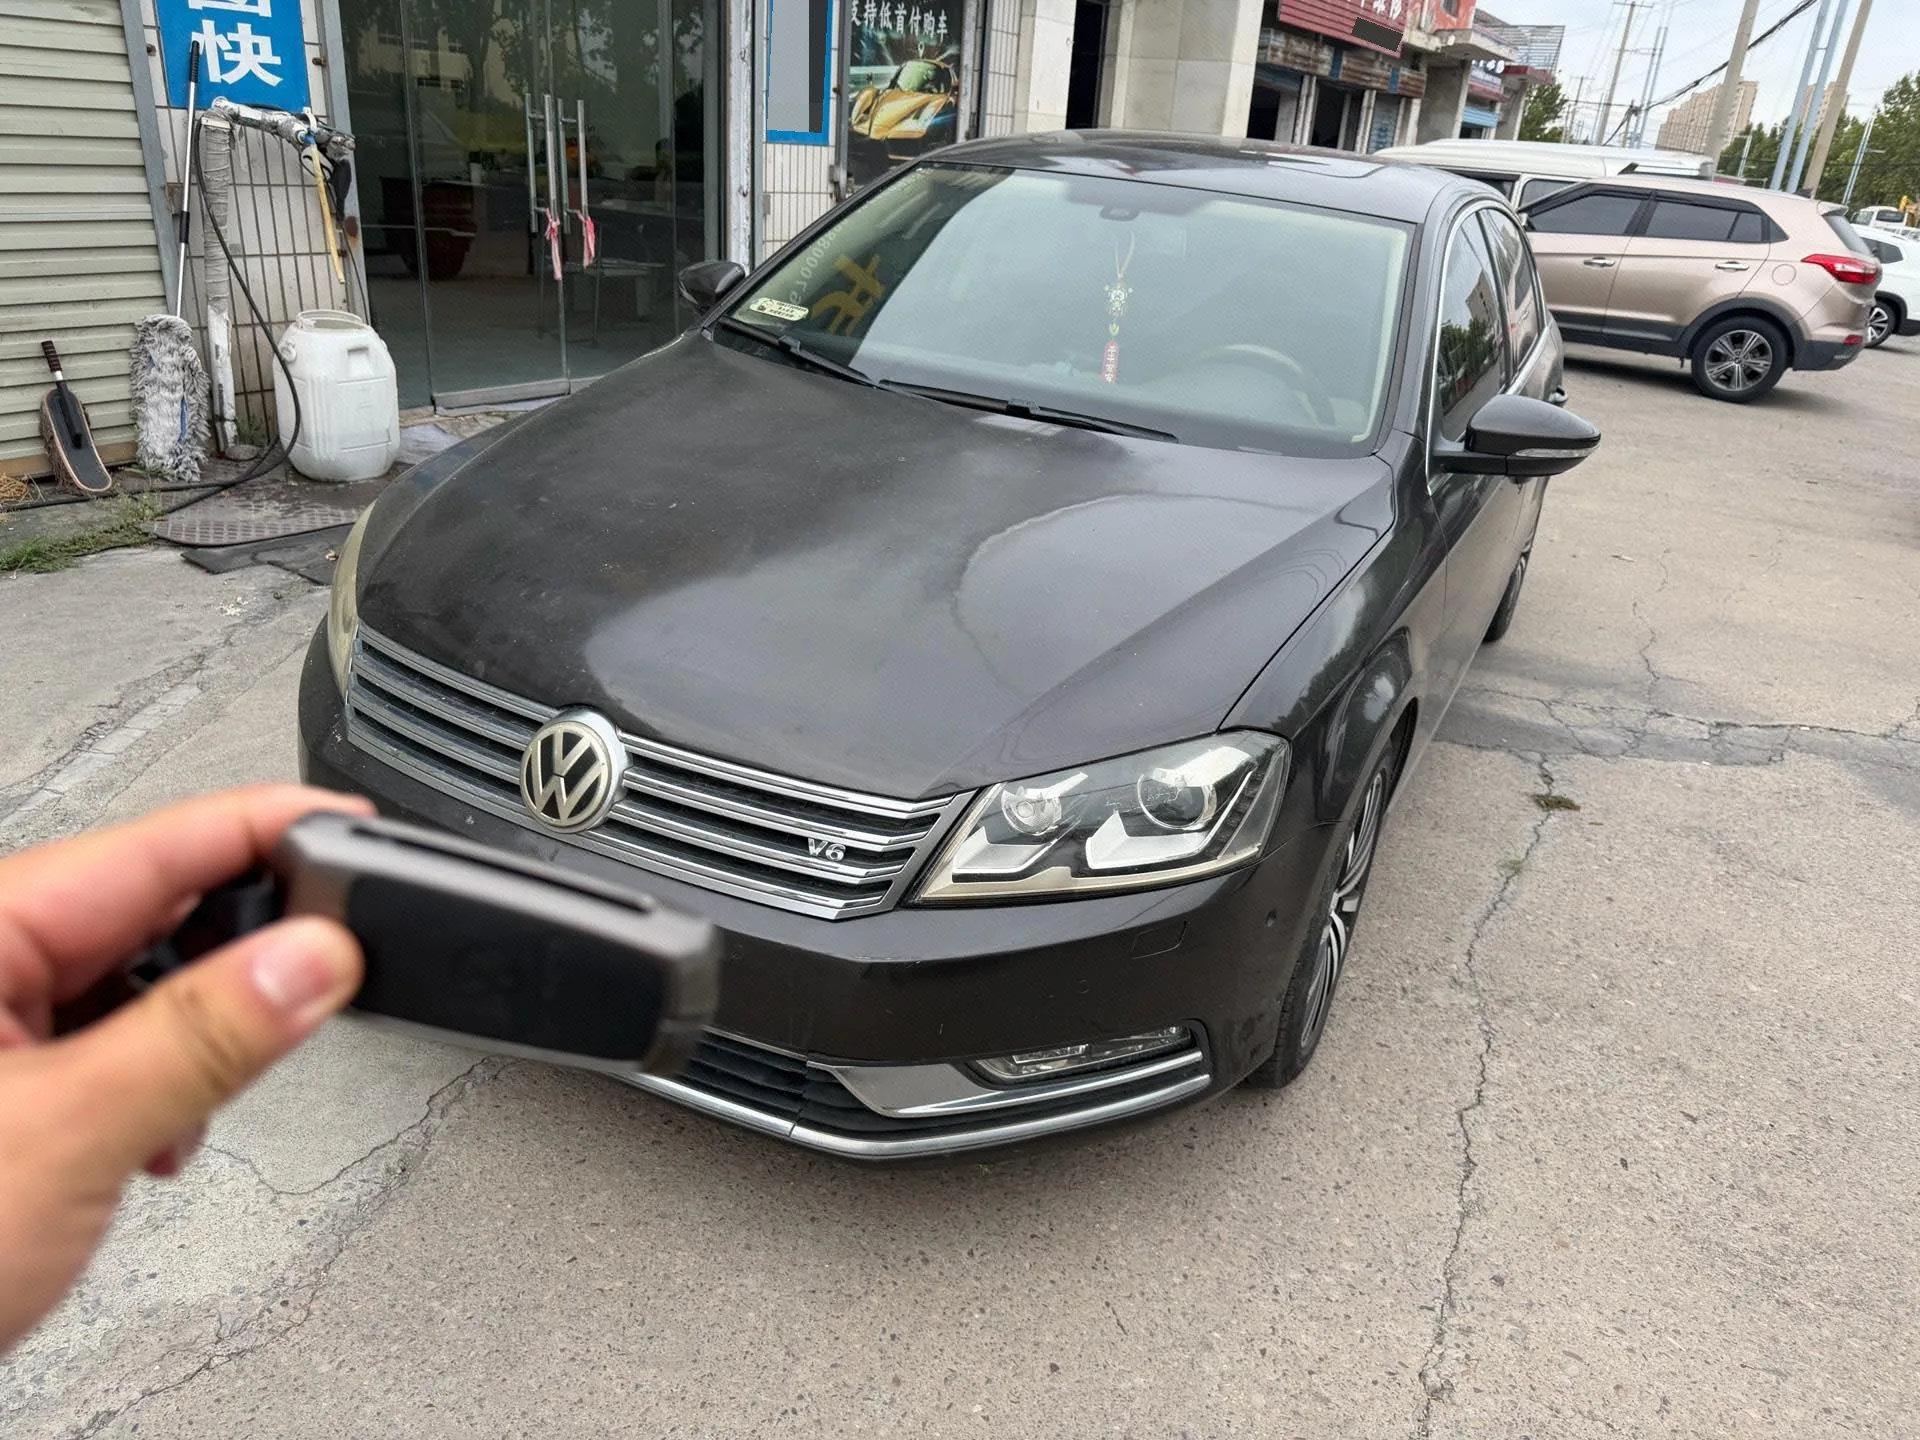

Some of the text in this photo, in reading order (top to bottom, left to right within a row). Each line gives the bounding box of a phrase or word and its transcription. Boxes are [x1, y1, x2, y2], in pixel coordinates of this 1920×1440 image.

[851, 0, 948, 43] 支持低首付购车
[188, 0, 284, 87] 快
[808, 838, 846, 861] V6
